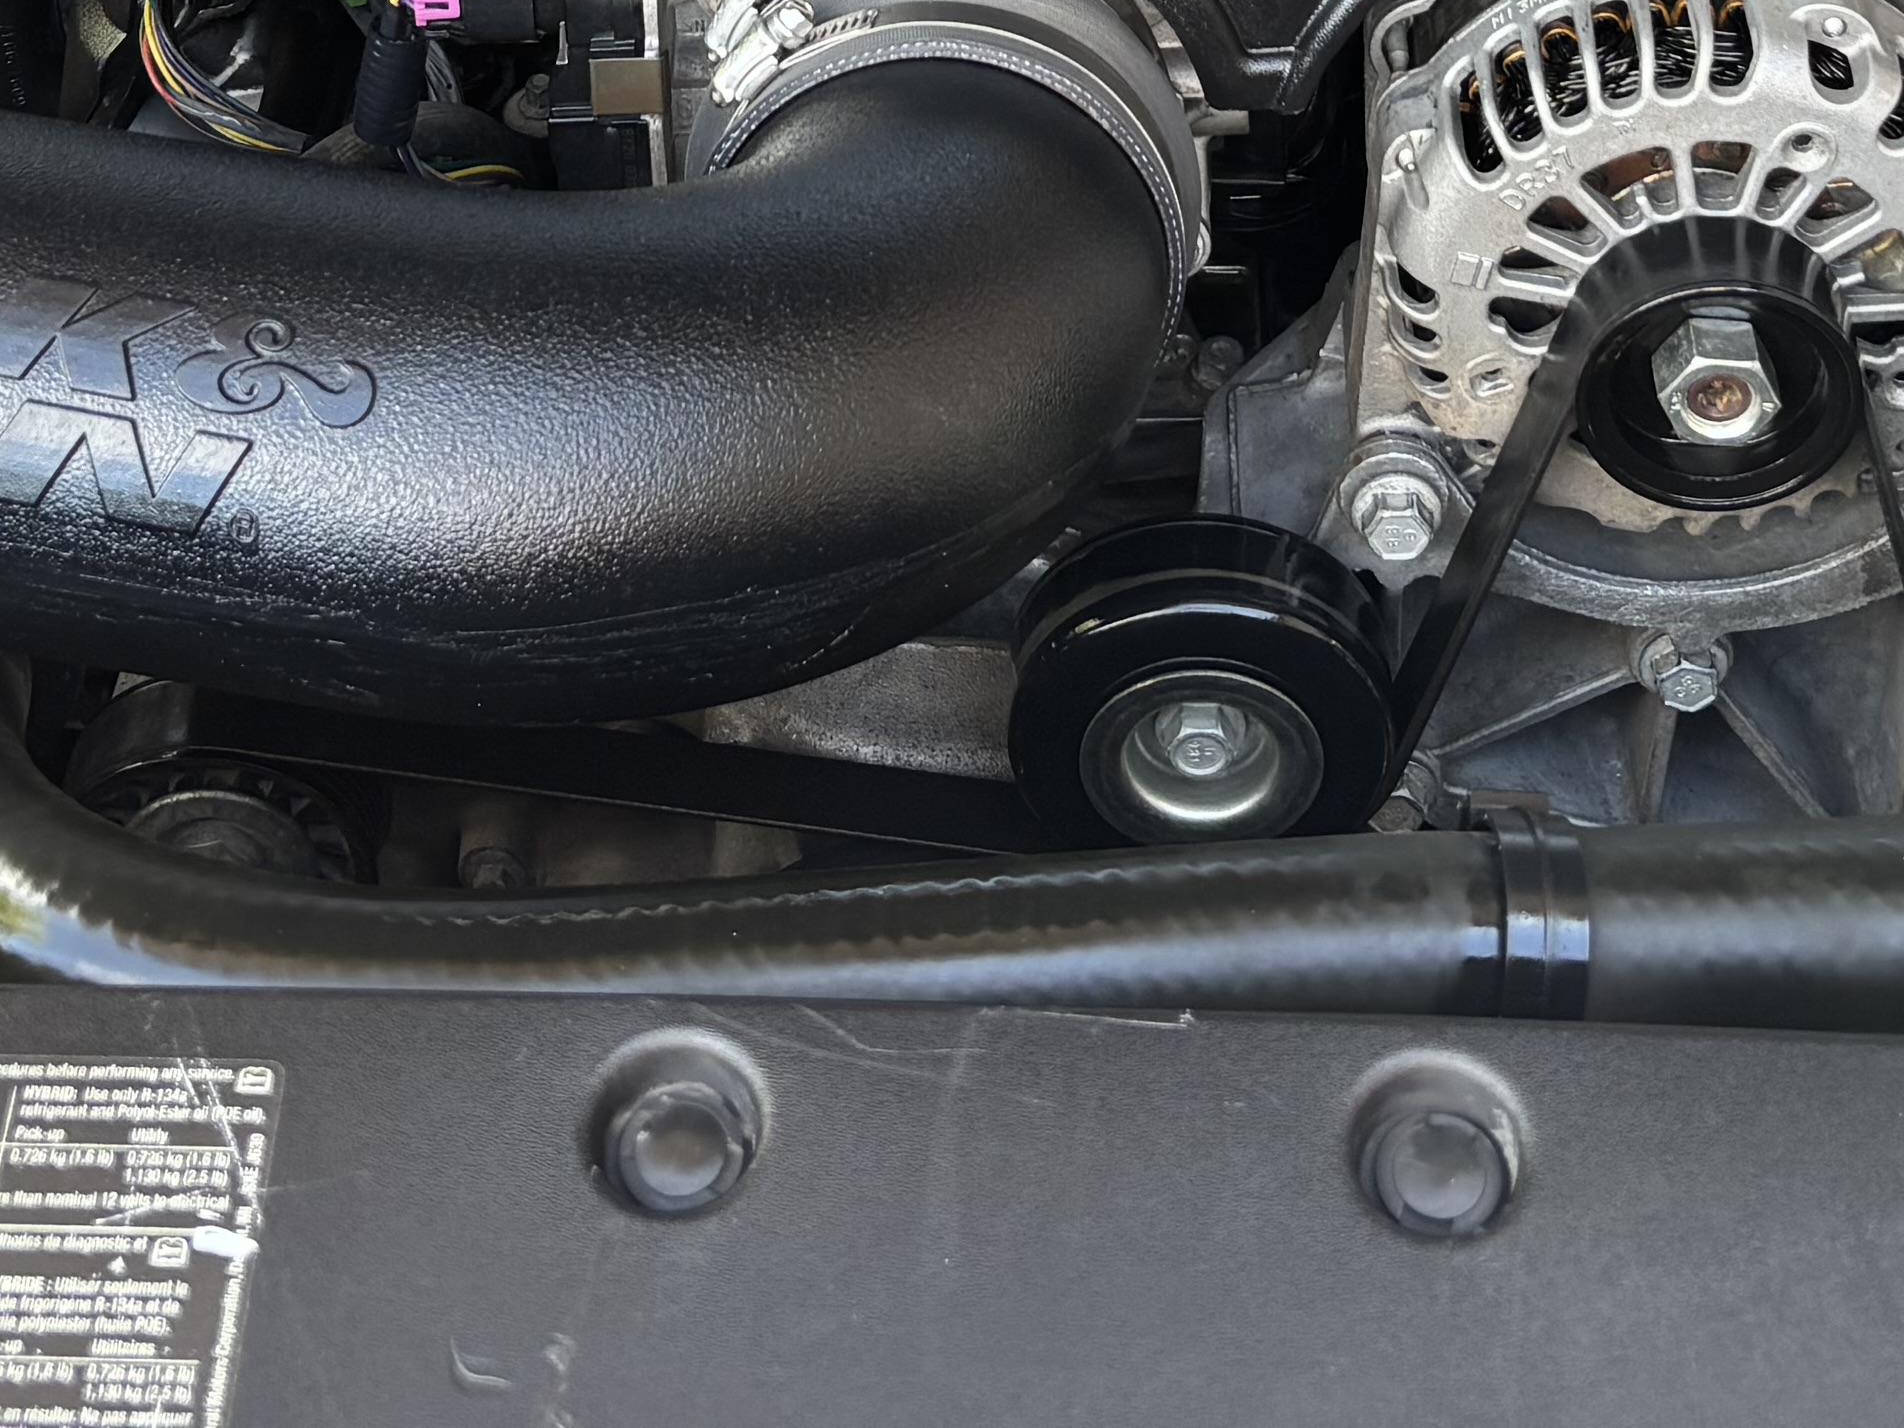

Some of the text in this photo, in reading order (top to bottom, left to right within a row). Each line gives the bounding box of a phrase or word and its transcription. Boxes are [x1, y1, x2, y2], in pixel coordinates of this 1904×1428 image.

[46, 1062, 88, 1077] before
[87, 1063, 160, 1081] performing
[186, 1065, 236, 1079] service.
[21, 1085, 189, 1104] HYBRID: Use only R-134a
[12, 1125, 67, 1142] Pick-up
[128, 1127, 171, 1144] Utility
[8, 1148, 118, 1167] 0.726 kg (1.6 lb)
[125, 1150, 232, 1169] 0.726 kg (1.6 lb)
[120, 1168, 229, 1188] 1.130 kg (2.5 lb)
[12, 1190, 43, 1205] than
[42, 1191, 98, 1207] nominal
[99, 1192, 118, 1207] 12
[117, 1192, 151, 1208] volts
[89, 1338, 158, 1356] Utilitaires
